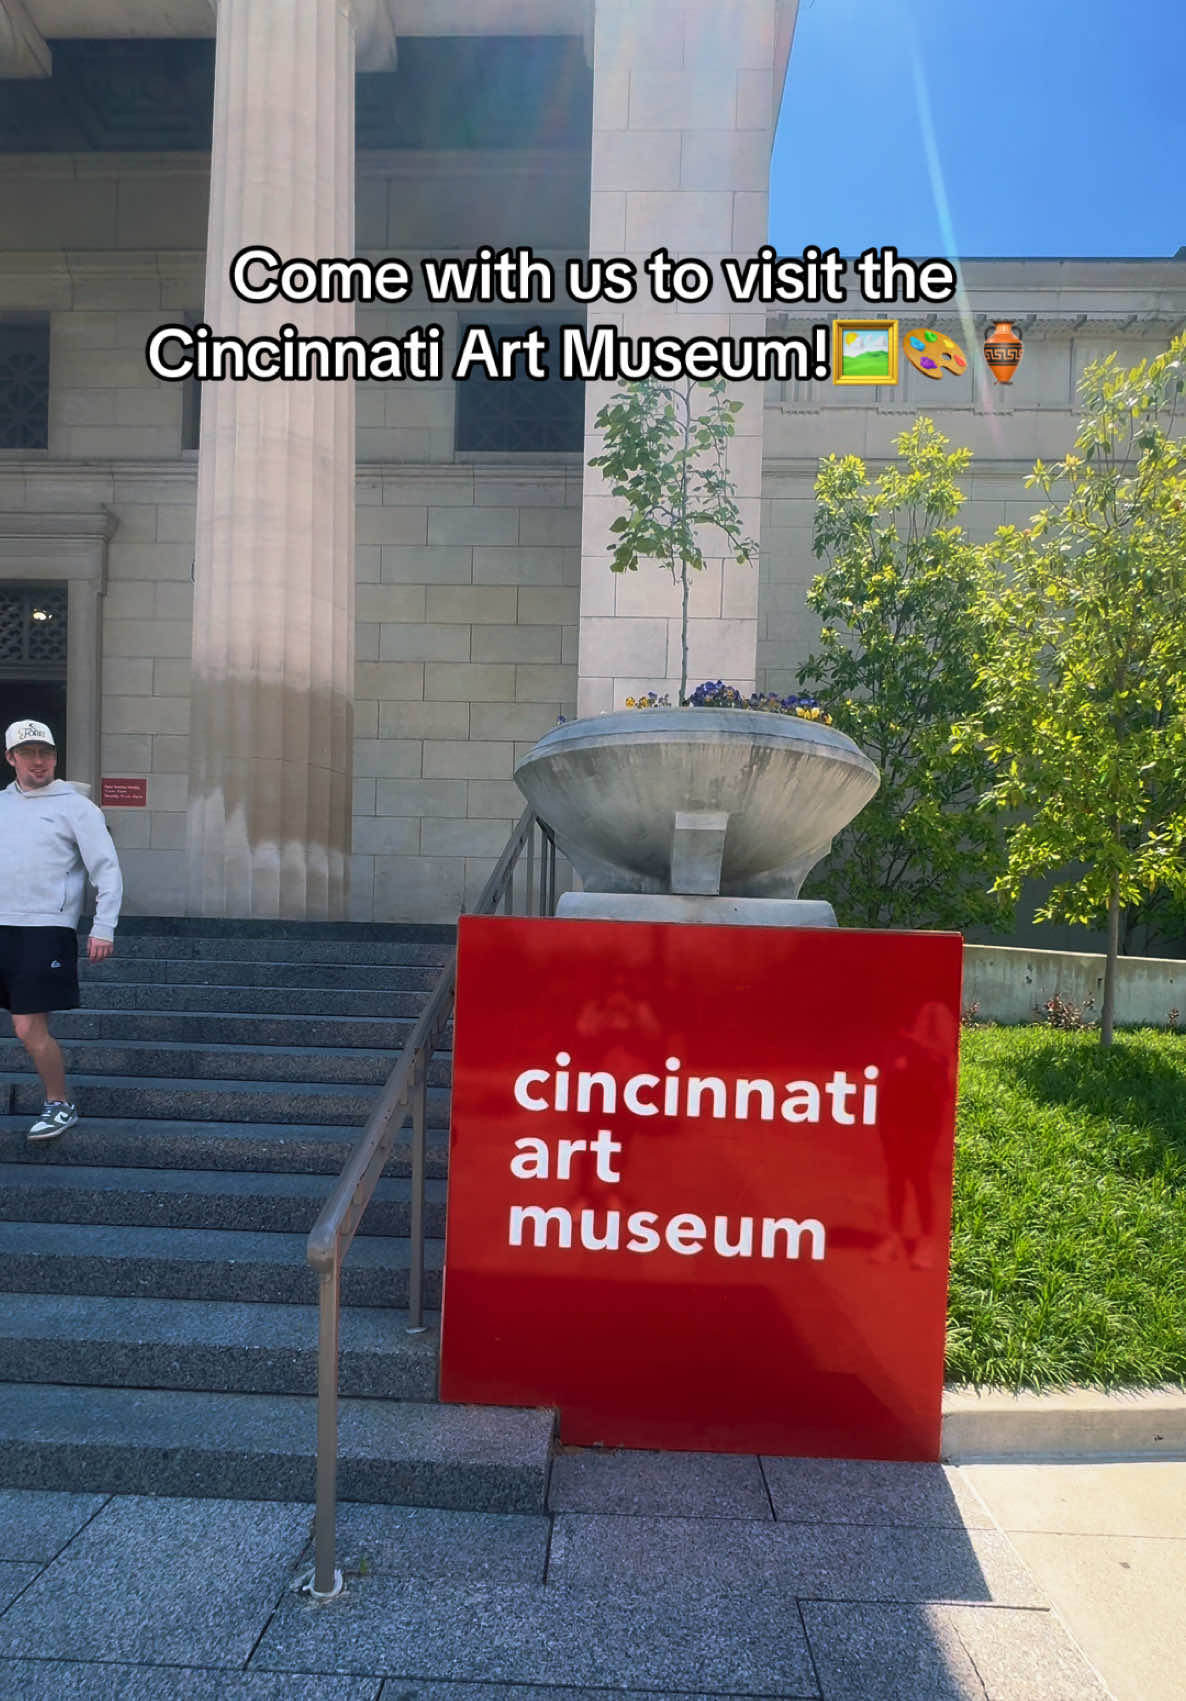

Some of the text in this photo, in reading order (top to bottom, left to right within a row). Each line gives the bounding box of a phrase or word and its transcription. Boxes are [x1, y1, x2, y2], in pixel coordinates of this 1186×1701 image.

[513, 1051, 879, 1126] cincinnati
[509, 1129, 623, 1184] art
[507, 1204, 827, 1261] museum
